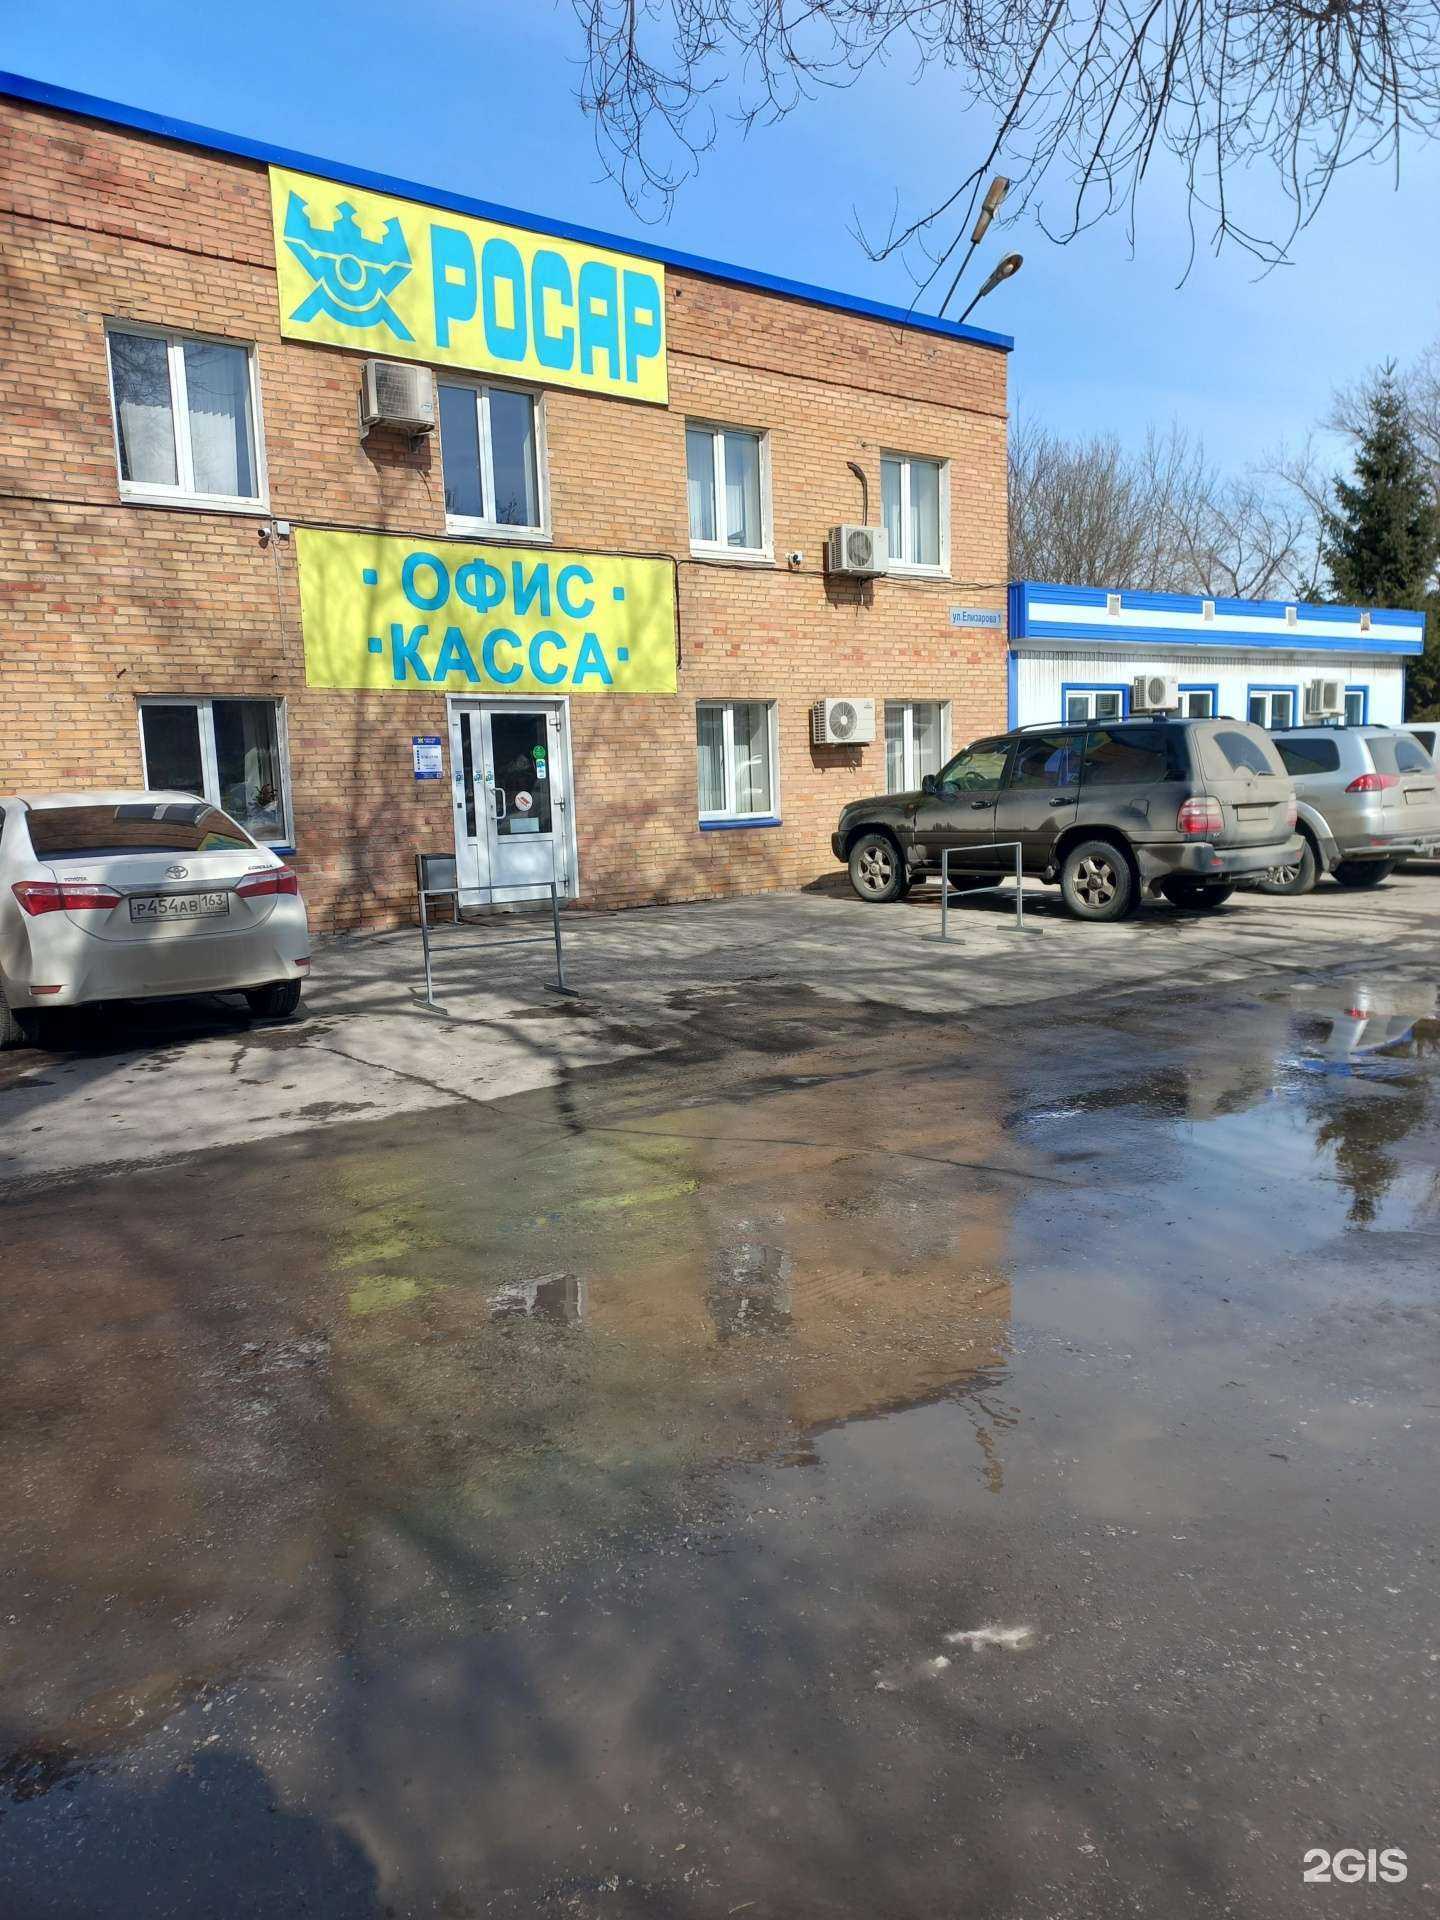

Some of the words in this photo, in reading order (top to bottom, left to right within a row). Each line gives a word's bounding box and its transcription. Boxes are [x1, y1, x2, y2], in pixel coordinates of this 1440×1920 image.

[430, 223, 662, 384] РОСАР
[402, 552, 595, 619] ОФИС
[391, 623, 613, 686] КАССА
[201, 894, 223, 907] 163
